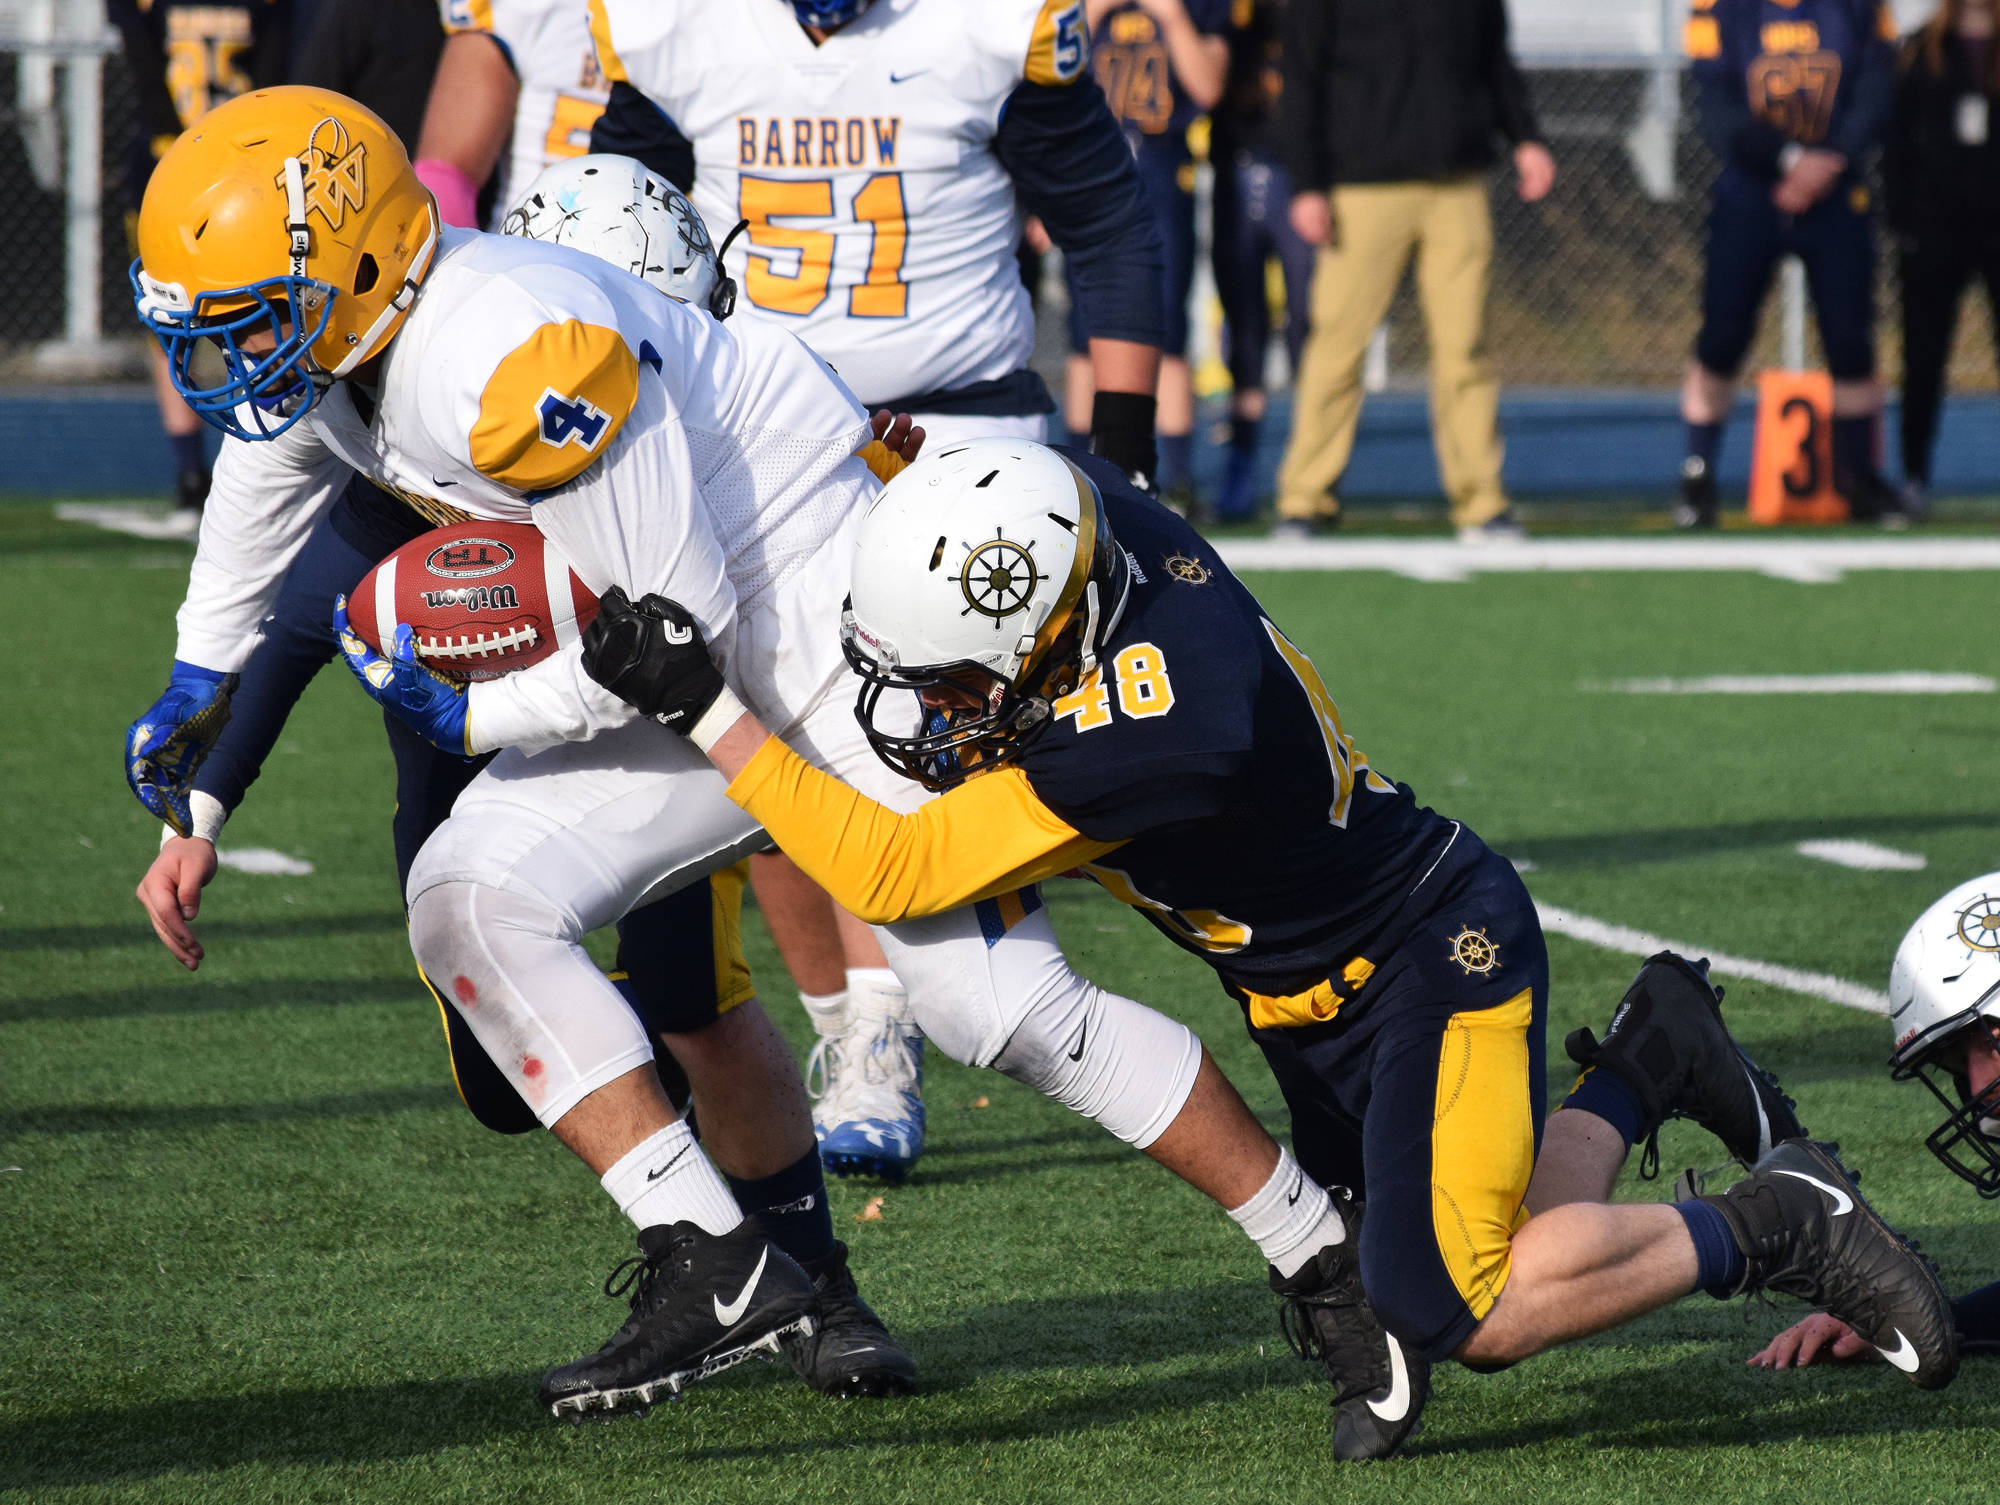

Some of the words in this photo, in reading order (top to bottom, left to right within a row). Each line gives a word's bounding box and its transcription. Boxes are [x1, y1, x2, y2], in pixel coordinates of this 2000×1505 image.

[737, 116, 902, 169] BARROW
[738, 172, 909, 319] 51
[533, 385, 613, 453] 4
[1781, 397, 1817, 497] 3
[424, 584, 520, 613] Wilson
[1126, 552, 1148, 584] Riddell
[1051, 642, 1176, 734] 48
